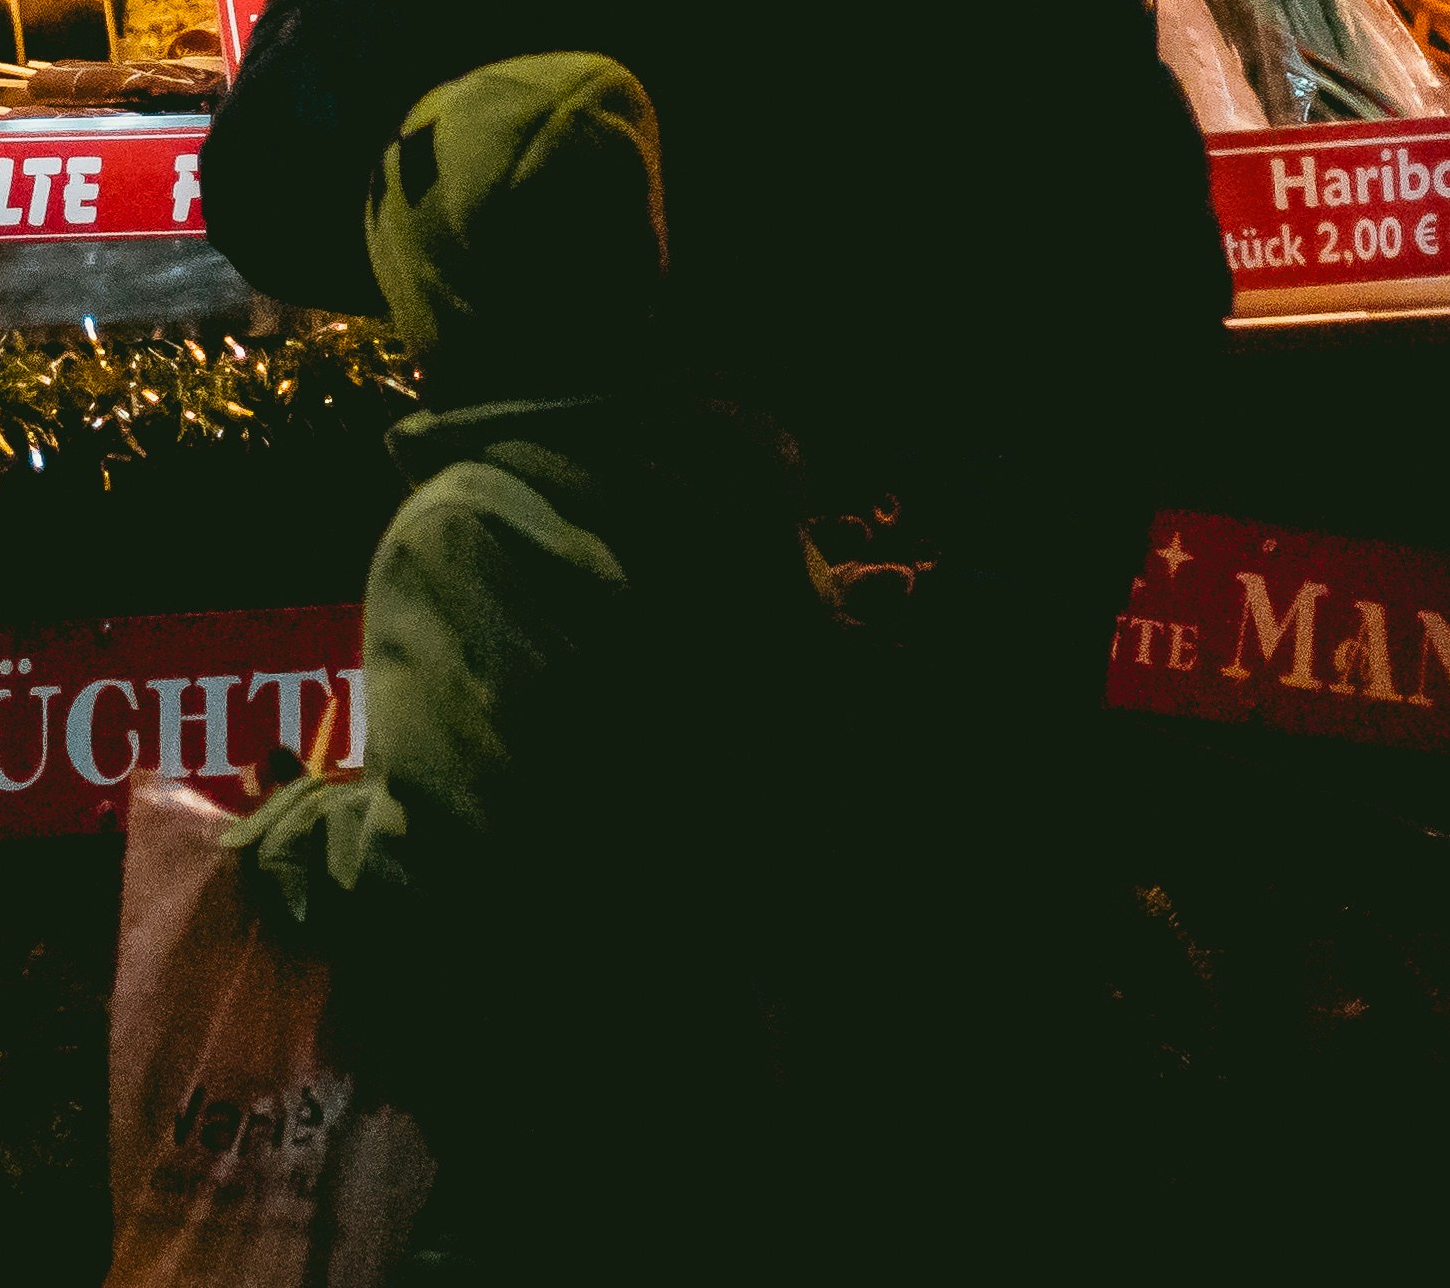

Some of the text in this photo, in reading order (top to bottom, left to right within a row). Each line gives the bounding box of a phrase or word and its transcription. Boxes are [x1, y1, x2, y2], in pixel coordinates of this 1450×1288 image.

[1226, 227, 1306, 271] tück
[1317, 218, 1402, 268] 2,00
[1413, 218, 1439, 255] €
